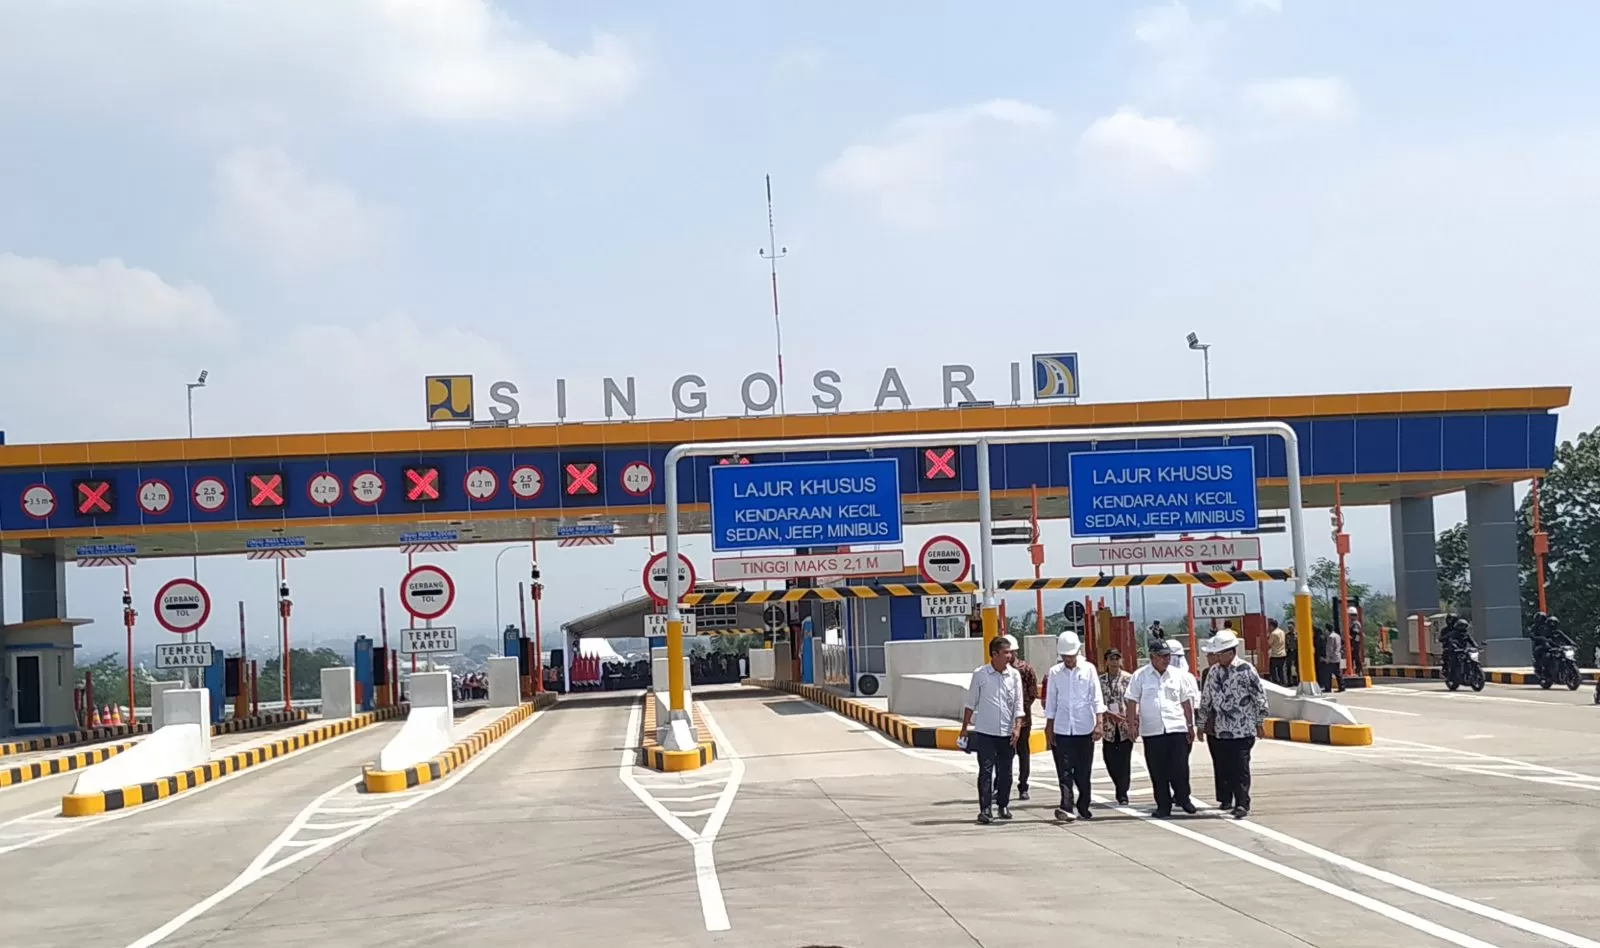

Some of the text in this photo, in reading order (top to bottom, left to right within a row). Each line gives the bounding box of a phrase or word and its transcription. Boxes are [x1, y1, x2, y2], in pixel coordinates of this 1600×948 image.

[489, 361, 1020, 422] SINGOSARI
[519, 475, 533, 483] 2.5
[626, 474, 639, 483] 4.2
[1092, 465, 1234, 485] LAJUR KHUSUS
[361, 480, 374, 489] 2.5
[470, 480, 483, 488] 4.2
[733, 477, 876, 498] LAJUR KHUSUS
[203, 487, 216, 495] 2.5
[313, 486, 327, 494] 4.2
[41, 497, 49, 505] m
[143, 492, 156, 501] 4.2
[1092, 491, 1237, 510] KENDARAAN KECIL
[734, 504, 881, 523] KENDARAAN KECIL
[1084, 508, 1245, 529] SEDAN, JEEP, MINIBUS
[725, 521, 889, 543] SEDAN, JEEP, MINIBUS
[928, 550, 961, 558] GERBANG
[1099, 543, 1235, 560] TINGGI MAKS 2,1 M
[740, 556, 880, 575] TINGGI MAKS 2,1 M
[408, 580, 444, 591] GERBANG
[163, 595, 200, 604] GERBANG
[420, 594, 435, 603] TOL
[925, 596, 968, 606] TEMPEL
[1198, 596, 1240, 606] TEMPEL
[175, 609, 190, 617] TOL
[929, 605, 966, 615] KARTU
[1201, 605, 1237, 615] KARTU
[652, 625, 689, 635] KAU
[407, 630, 454, 641] TEMPEL
[160, 644, 208, 657] TEMPEL
[411, 640, 450, 651] KARTU
[164, 654, 204, 666] KARTU
